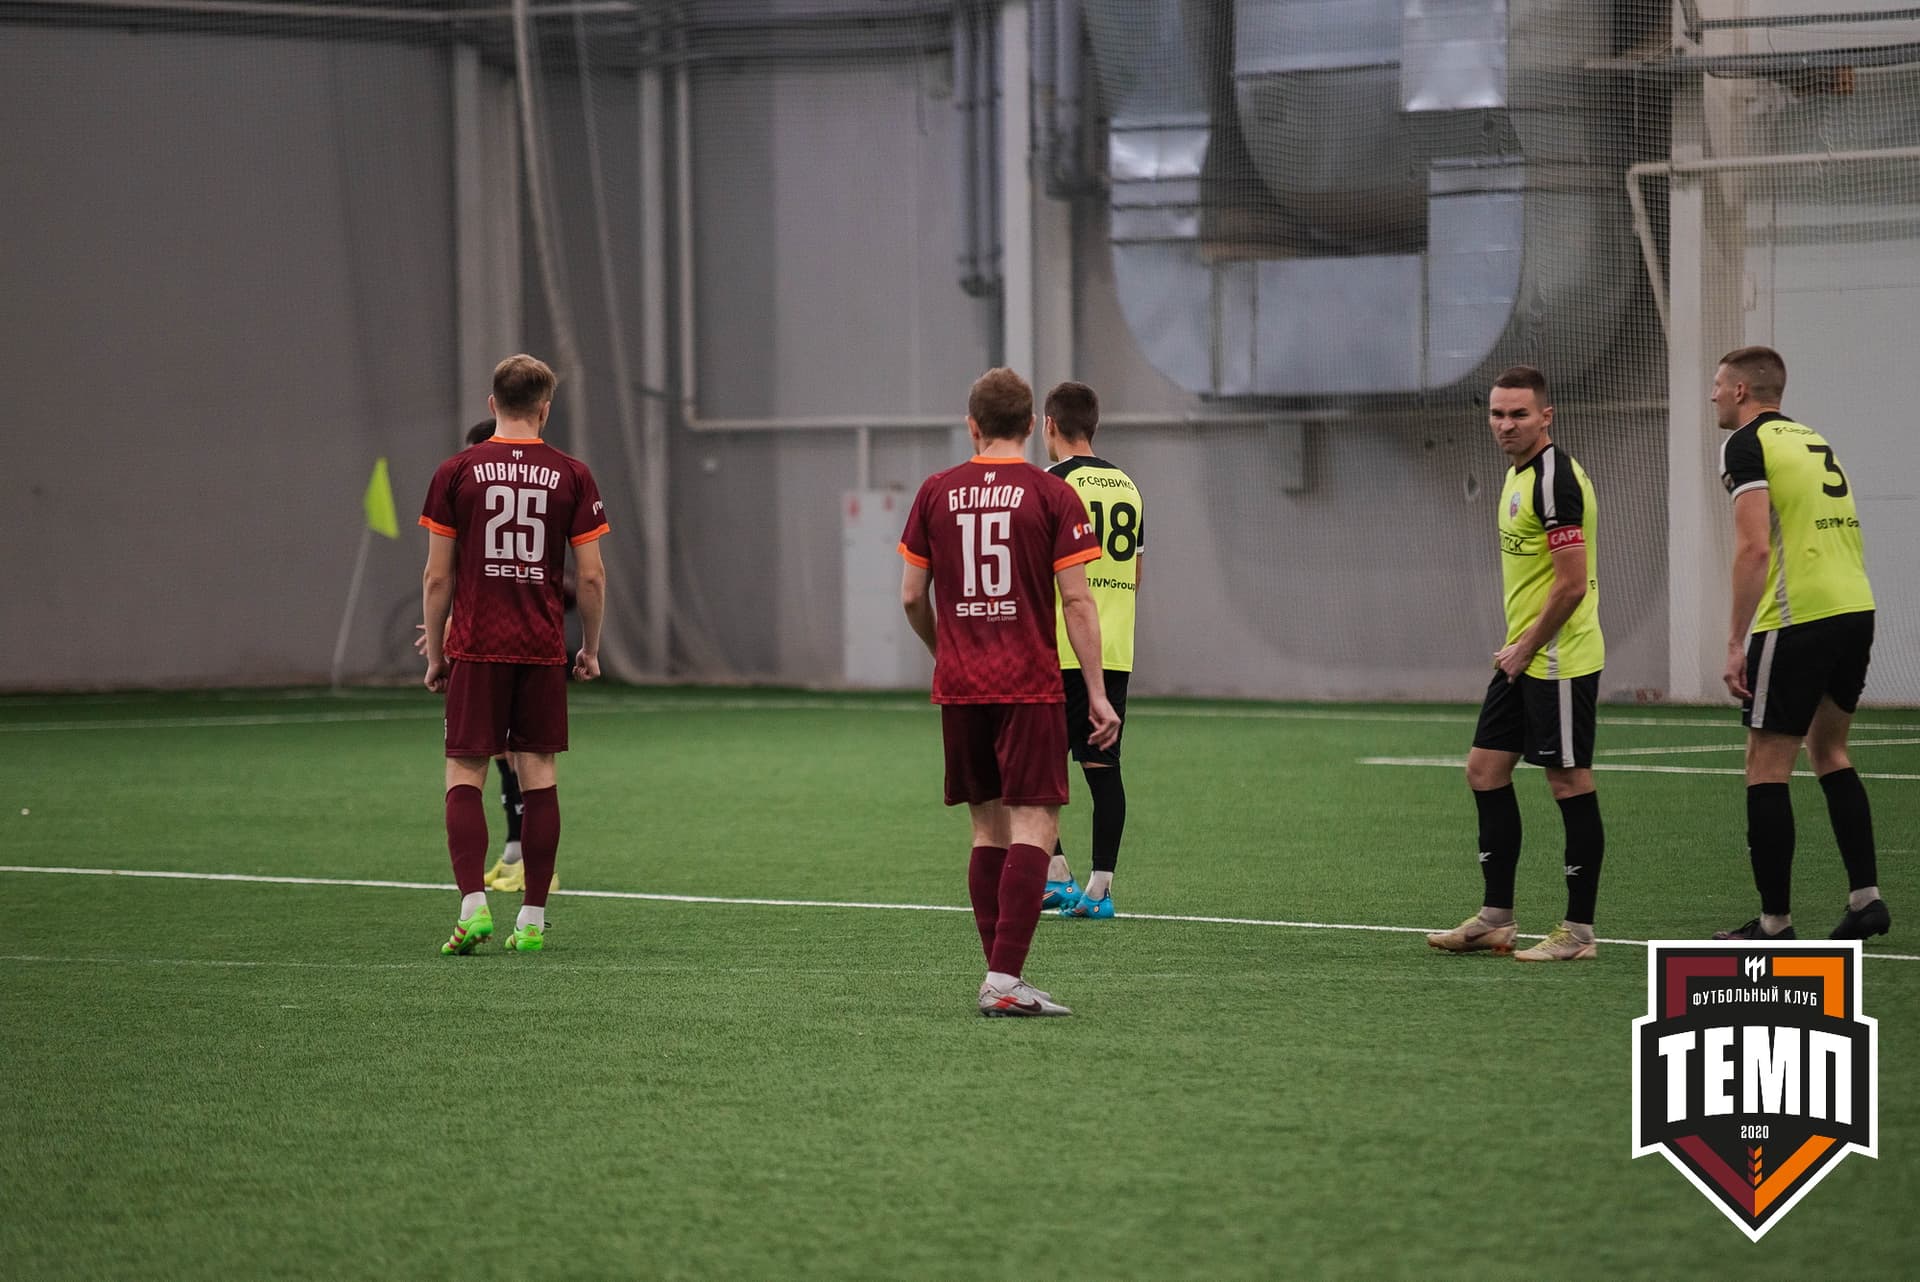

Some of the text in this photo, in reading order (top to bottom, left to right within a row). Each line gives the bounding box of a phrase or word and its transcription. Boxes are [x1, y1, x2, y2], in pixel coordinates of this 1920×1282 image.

[473, 462, 561, 490] НОВИЧКОВ
[1806, 444, 1848, 498] 3
[948, 485, 1025, 512] БЕЛИКОВ
[485, 485, 548, 562] 25
[1090, 501, 1136, 561] 18
[485, 564, 544, 580] SEUS
[956, 511, 1011, 597] 15
[956, 601, 1017, 617] SEUS
